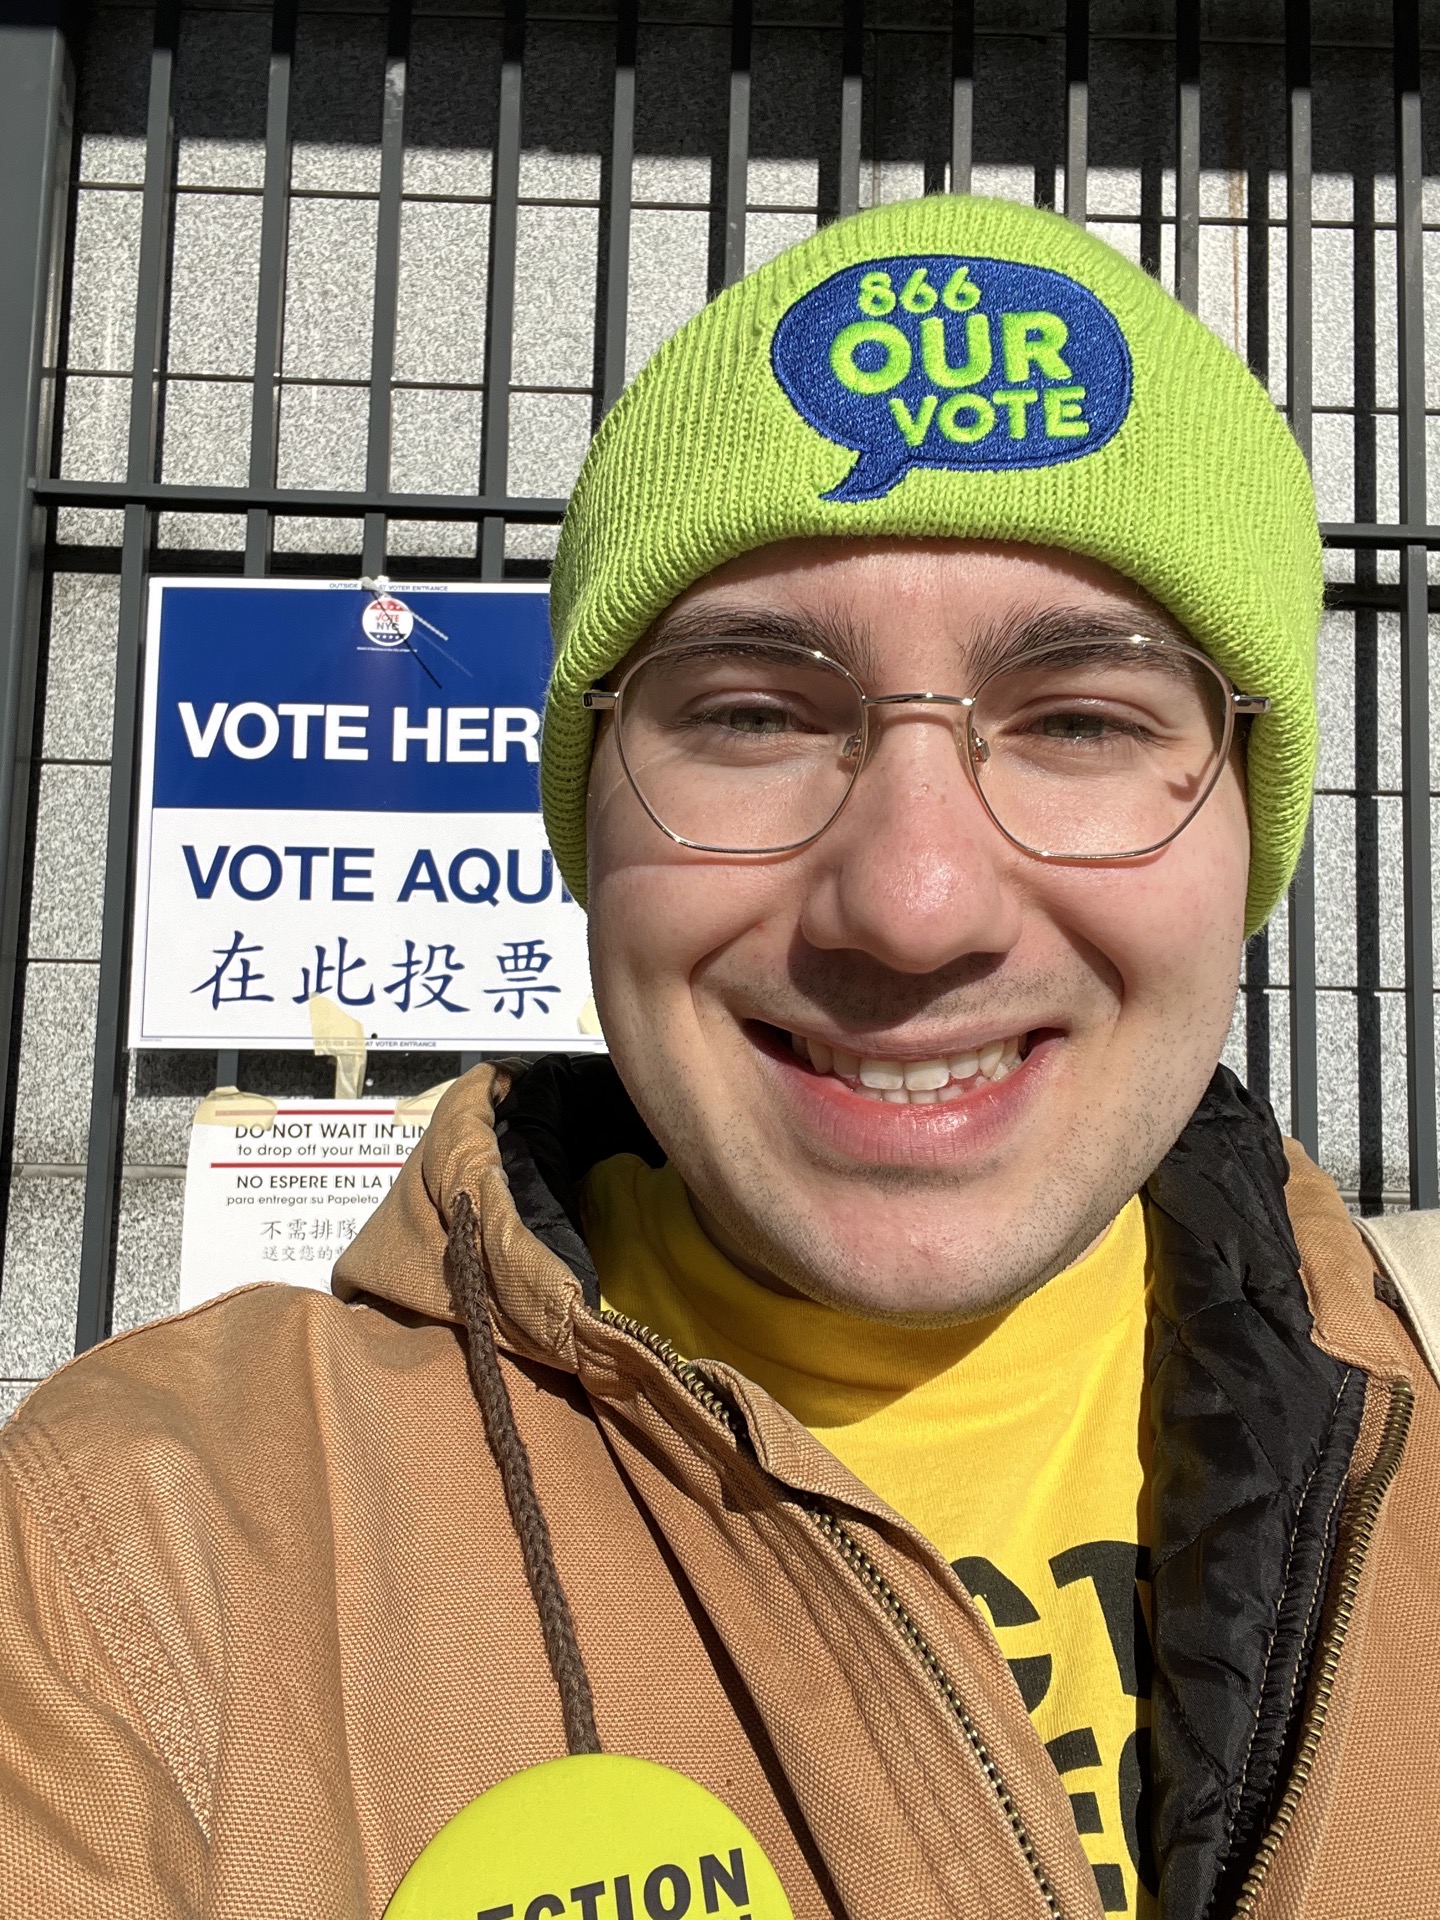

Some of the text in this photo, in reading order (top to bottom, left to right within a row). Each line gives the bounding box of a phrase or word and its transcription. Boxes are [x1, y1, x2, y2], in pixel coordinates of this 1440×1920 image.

[857, 266, 982, 317] 866
[829, 310, 1073, 395] OUR
[888, 386, 1090, 447] VOTE
[376, 622, 400, 631] NYC
[178, 701, 540, 763] VOTE HER
[182, 845, 574, 906] VOTE AQU
[190, 930, 561, 1019] 在此投票
[235, 1124, 265, 1139] DO
[272, 1123, 313, 1139] NOT
[320, 1124, 367, 1139] WAIT
[374, 1123, 394, 1139] IN
[238, 1145, 252, 1156] to
[257, 1144, 292, 1158] drop
[298, 1144, 316, 1156] off
[322, 1147, 353, 1158] your
[359, 1144, 390, 1156] Mail
[227, 1194, 378, 1206] para entregar su Papeleta
[237, 1175, 263, 1189] NO
[270, 1175, 328, 1189] ESPERE
[335, 1175, 355, 1189] EN
[362, 1175, 382, 1189] LA
[261, 1218, 358, 1241] 不需排隊
